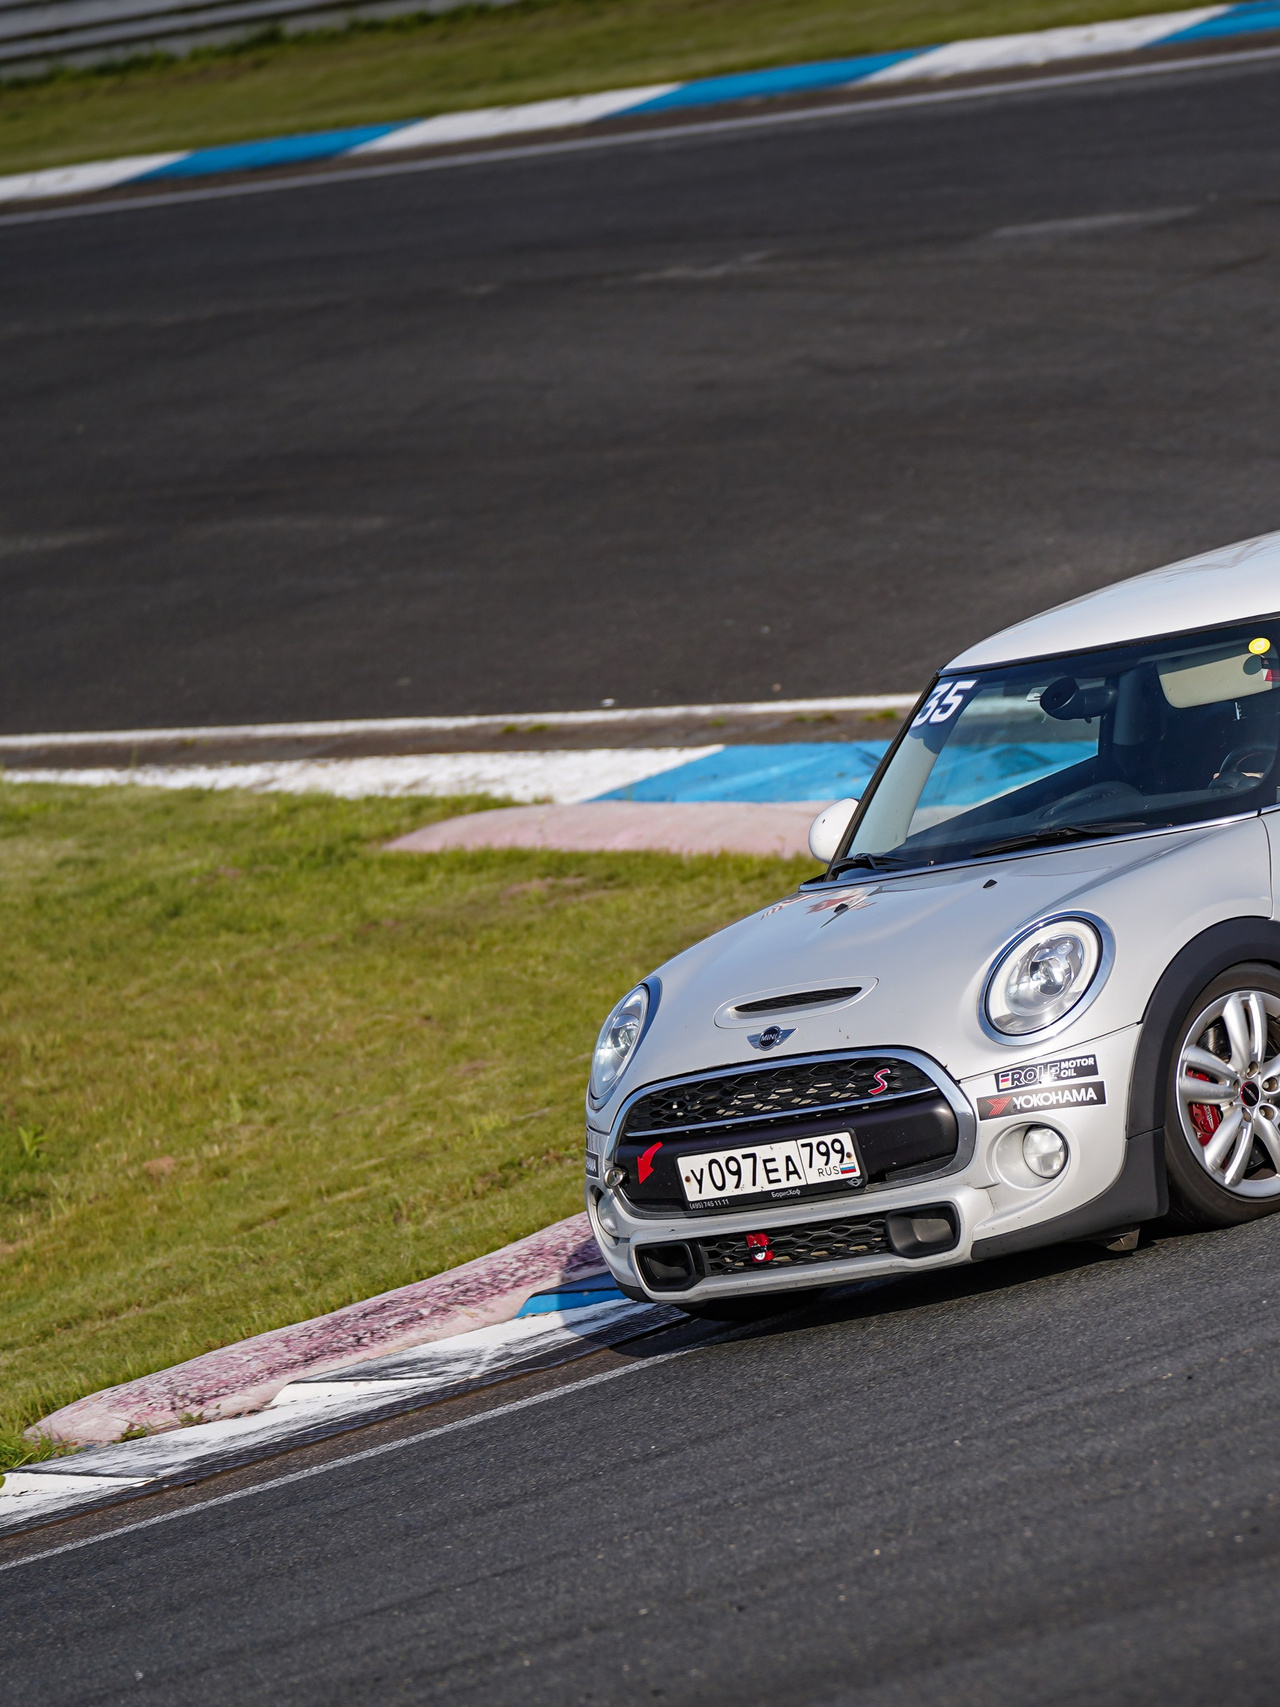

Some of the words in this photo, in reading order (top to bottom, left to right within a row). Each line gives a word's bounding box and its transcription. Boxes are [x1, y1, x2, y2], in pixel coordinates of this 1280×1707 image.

[760, 1033, 778, 1041] MINI
[1060, 1057, 1095, 1070] MOTOR
[1060, 1069, 1077, 1078] OIL
[868, 1068, 891, 1095] S
[1012, 1087, 1097, 1110] YOKOHAMA
[800, 1138, 845, 1169] 799
[817, 1167, 840, 1177] RUS
